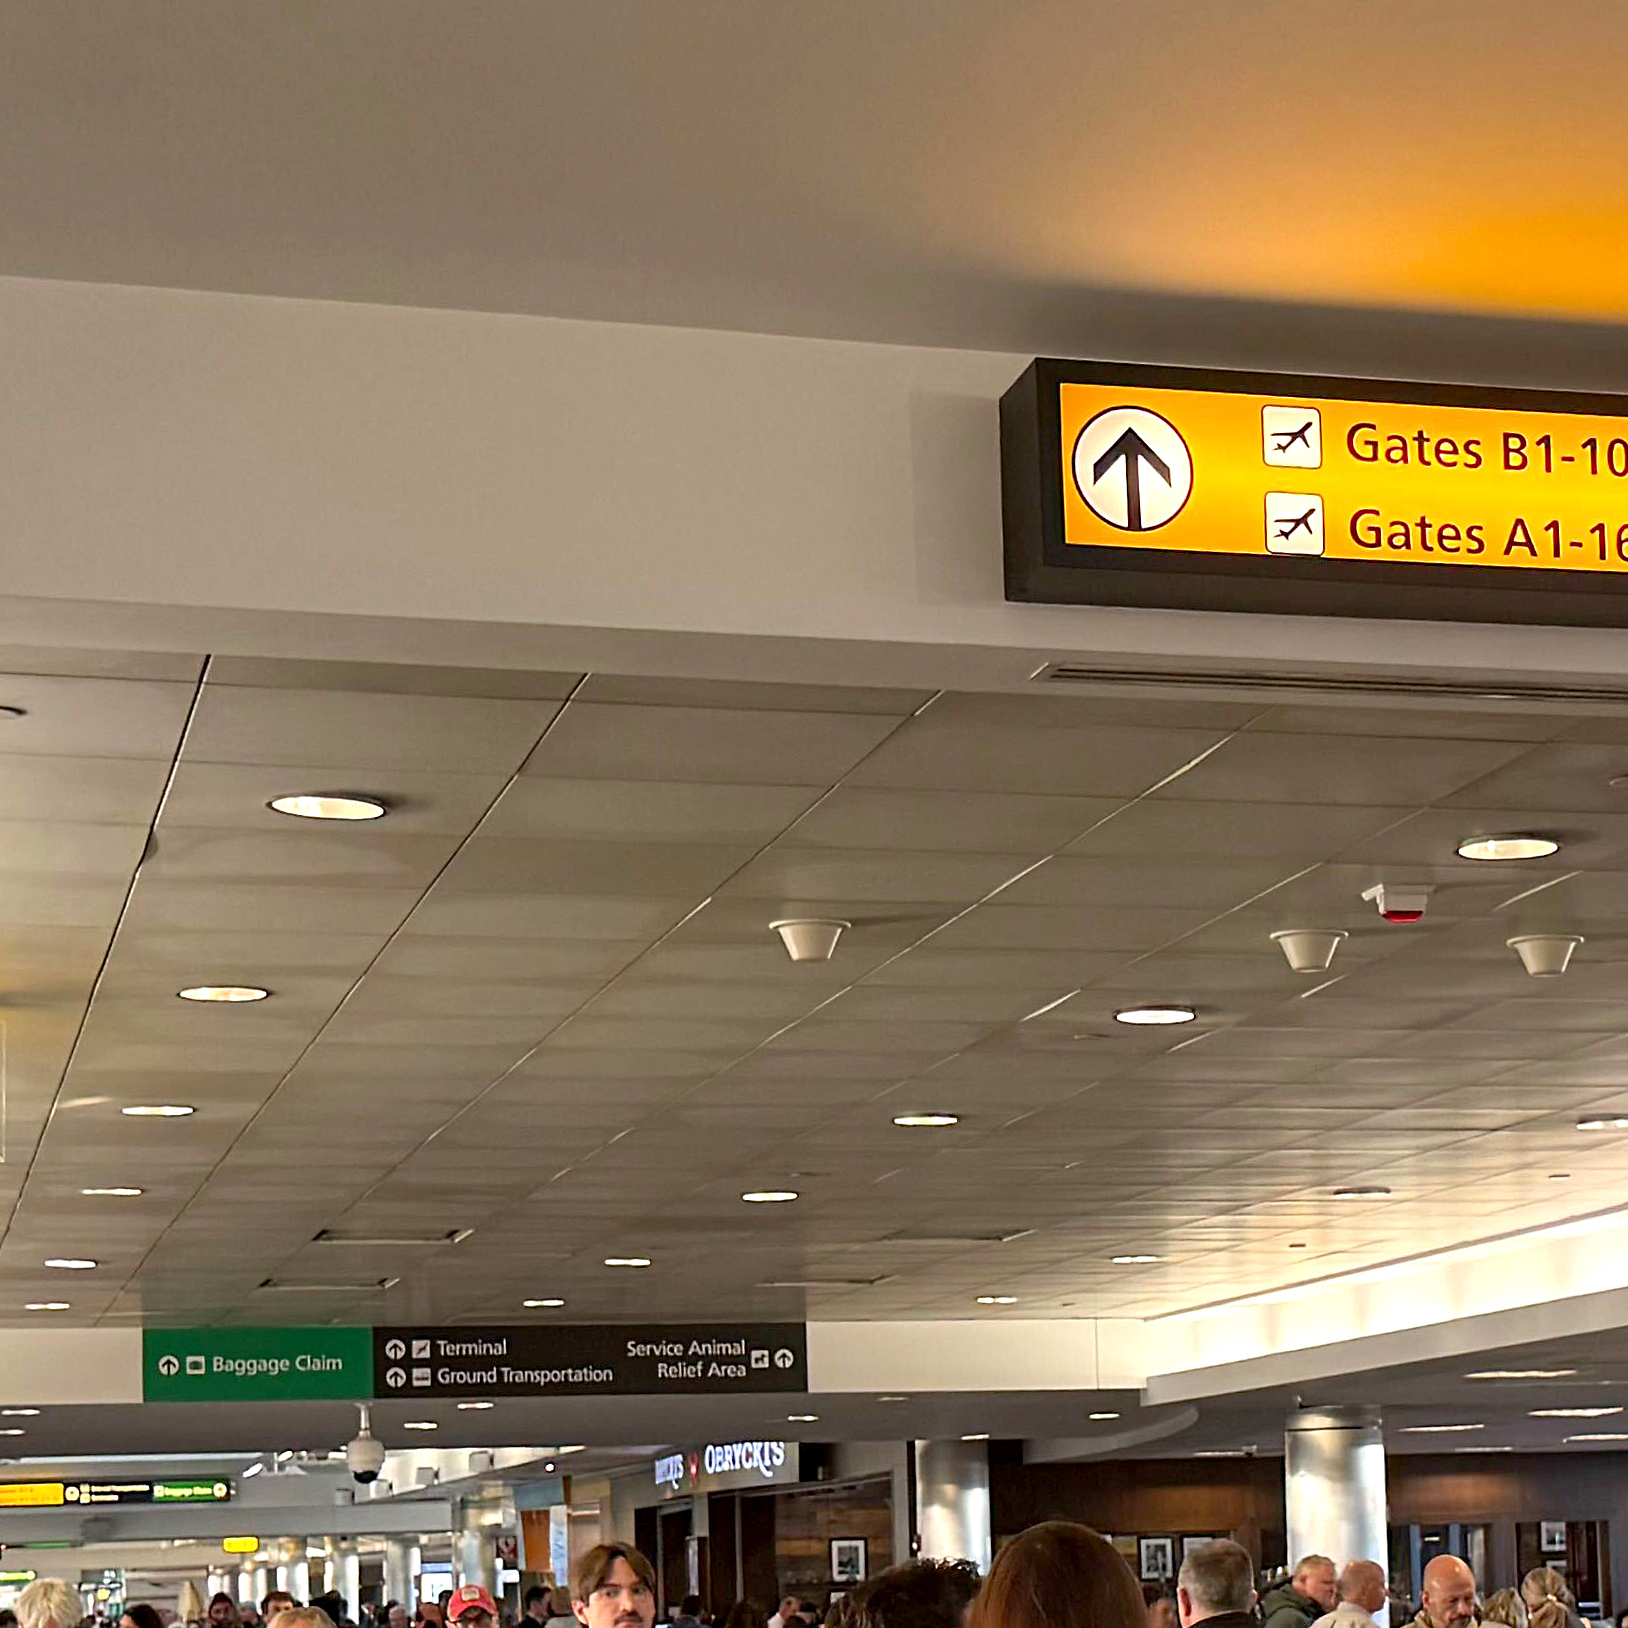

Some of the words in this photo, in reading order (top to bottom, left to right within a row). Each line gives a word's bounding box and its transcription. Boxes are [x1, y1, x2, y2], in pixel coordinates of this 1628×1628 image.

[1346, 422, 1483, 470] Gates
[1349, 508, 1485, 554] Gates
[437, 1338, 507, 1356] Terminal
[626, 1340, 684, 1357] Service
[688, 1339, 746, 1356] Animal
[213, 1356, 290, 1376] Baggage
[295, 1354, 343, 1371] Claim
[437, 1366, 497, 1384] Ground
[501, 1365, 613, 1386] Transportation
[657, 1361, 704, 1378] Relief
[707, 1362, 747, 1378] Area
